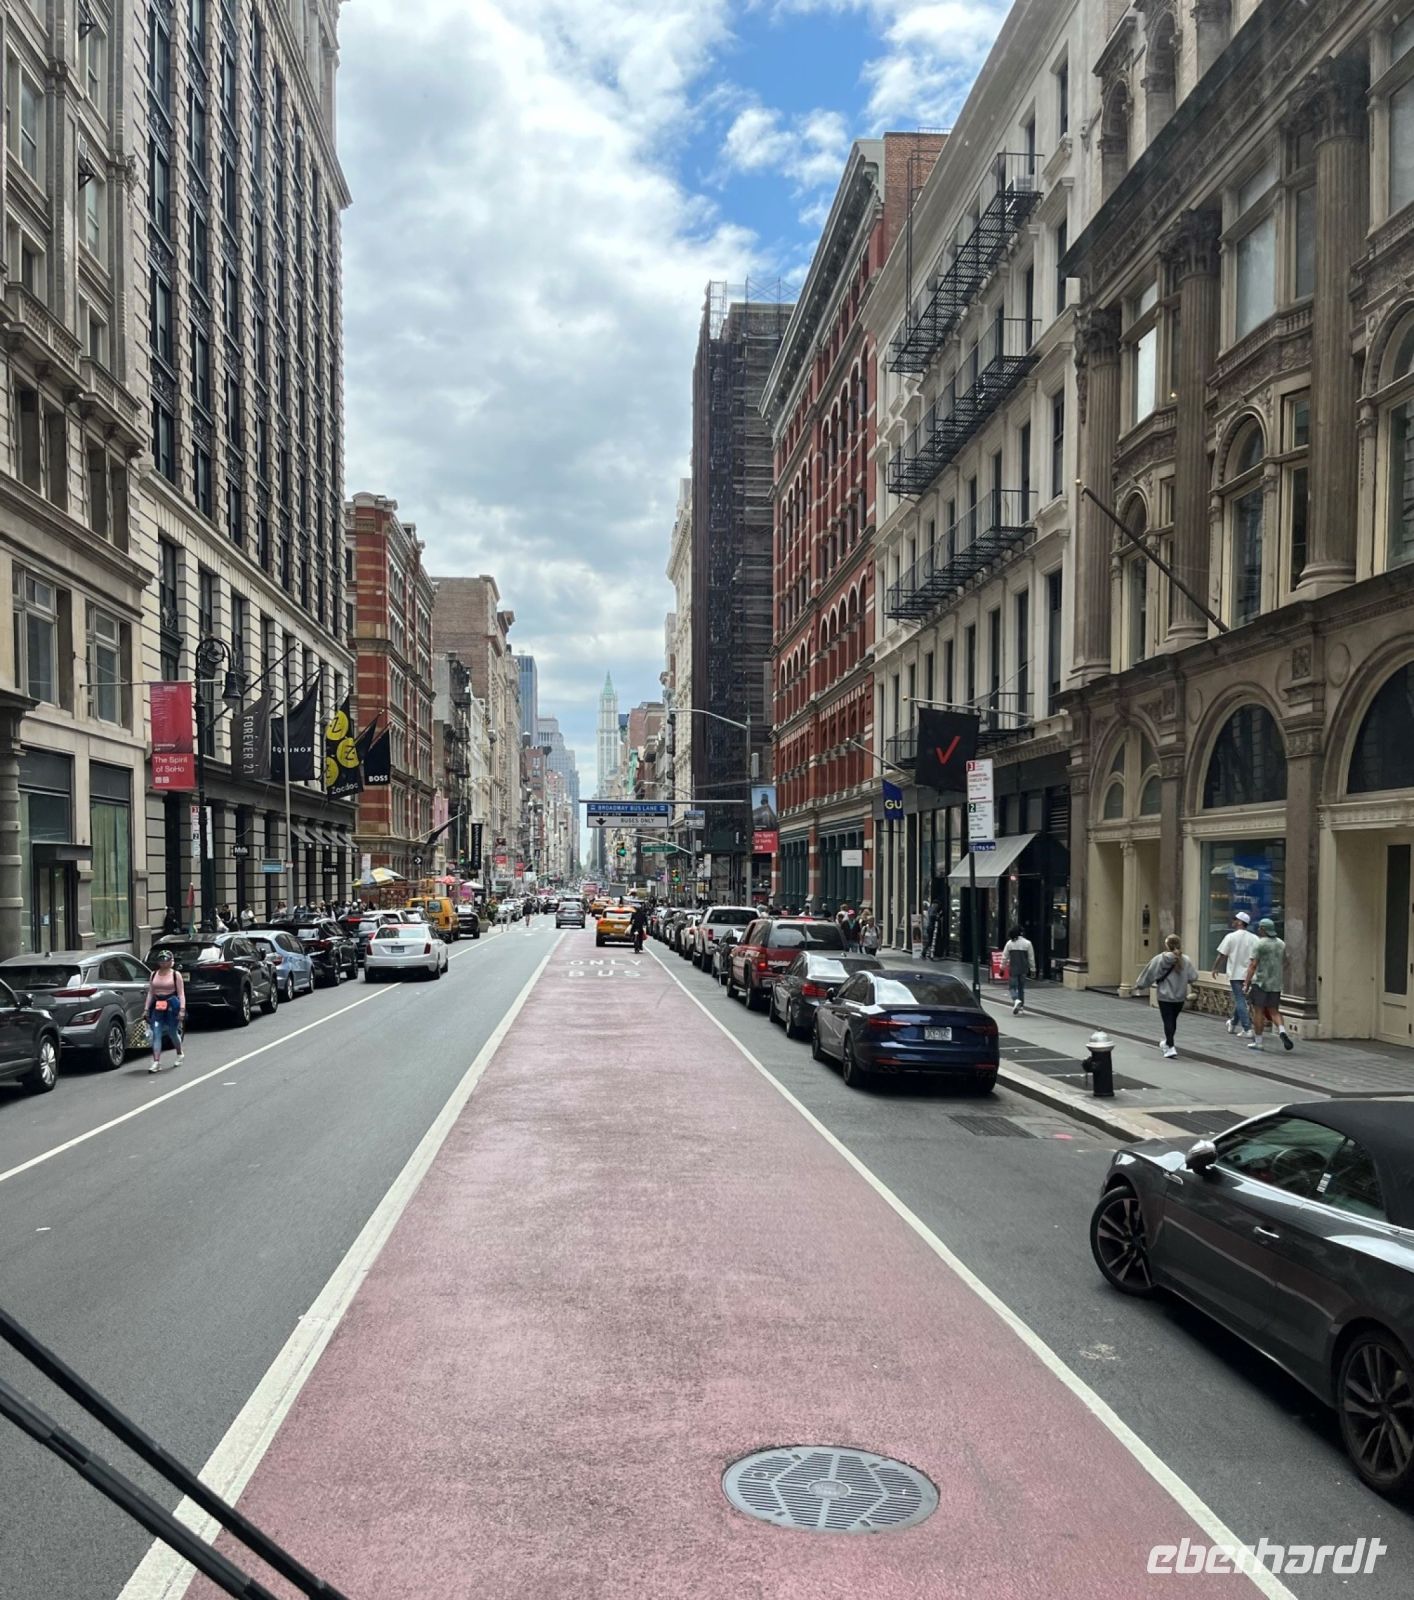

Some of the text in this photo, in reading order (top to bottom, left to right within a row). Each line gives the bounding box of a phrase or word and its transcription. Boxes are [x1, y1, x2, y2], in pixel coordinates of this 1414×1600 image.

[243, 715, 255, 774] FOREVER 21
[169, 756, 188, 765] Spirit
[155, 765, 185, 773] of SoHo
[885, 799, 902, 810] GU
